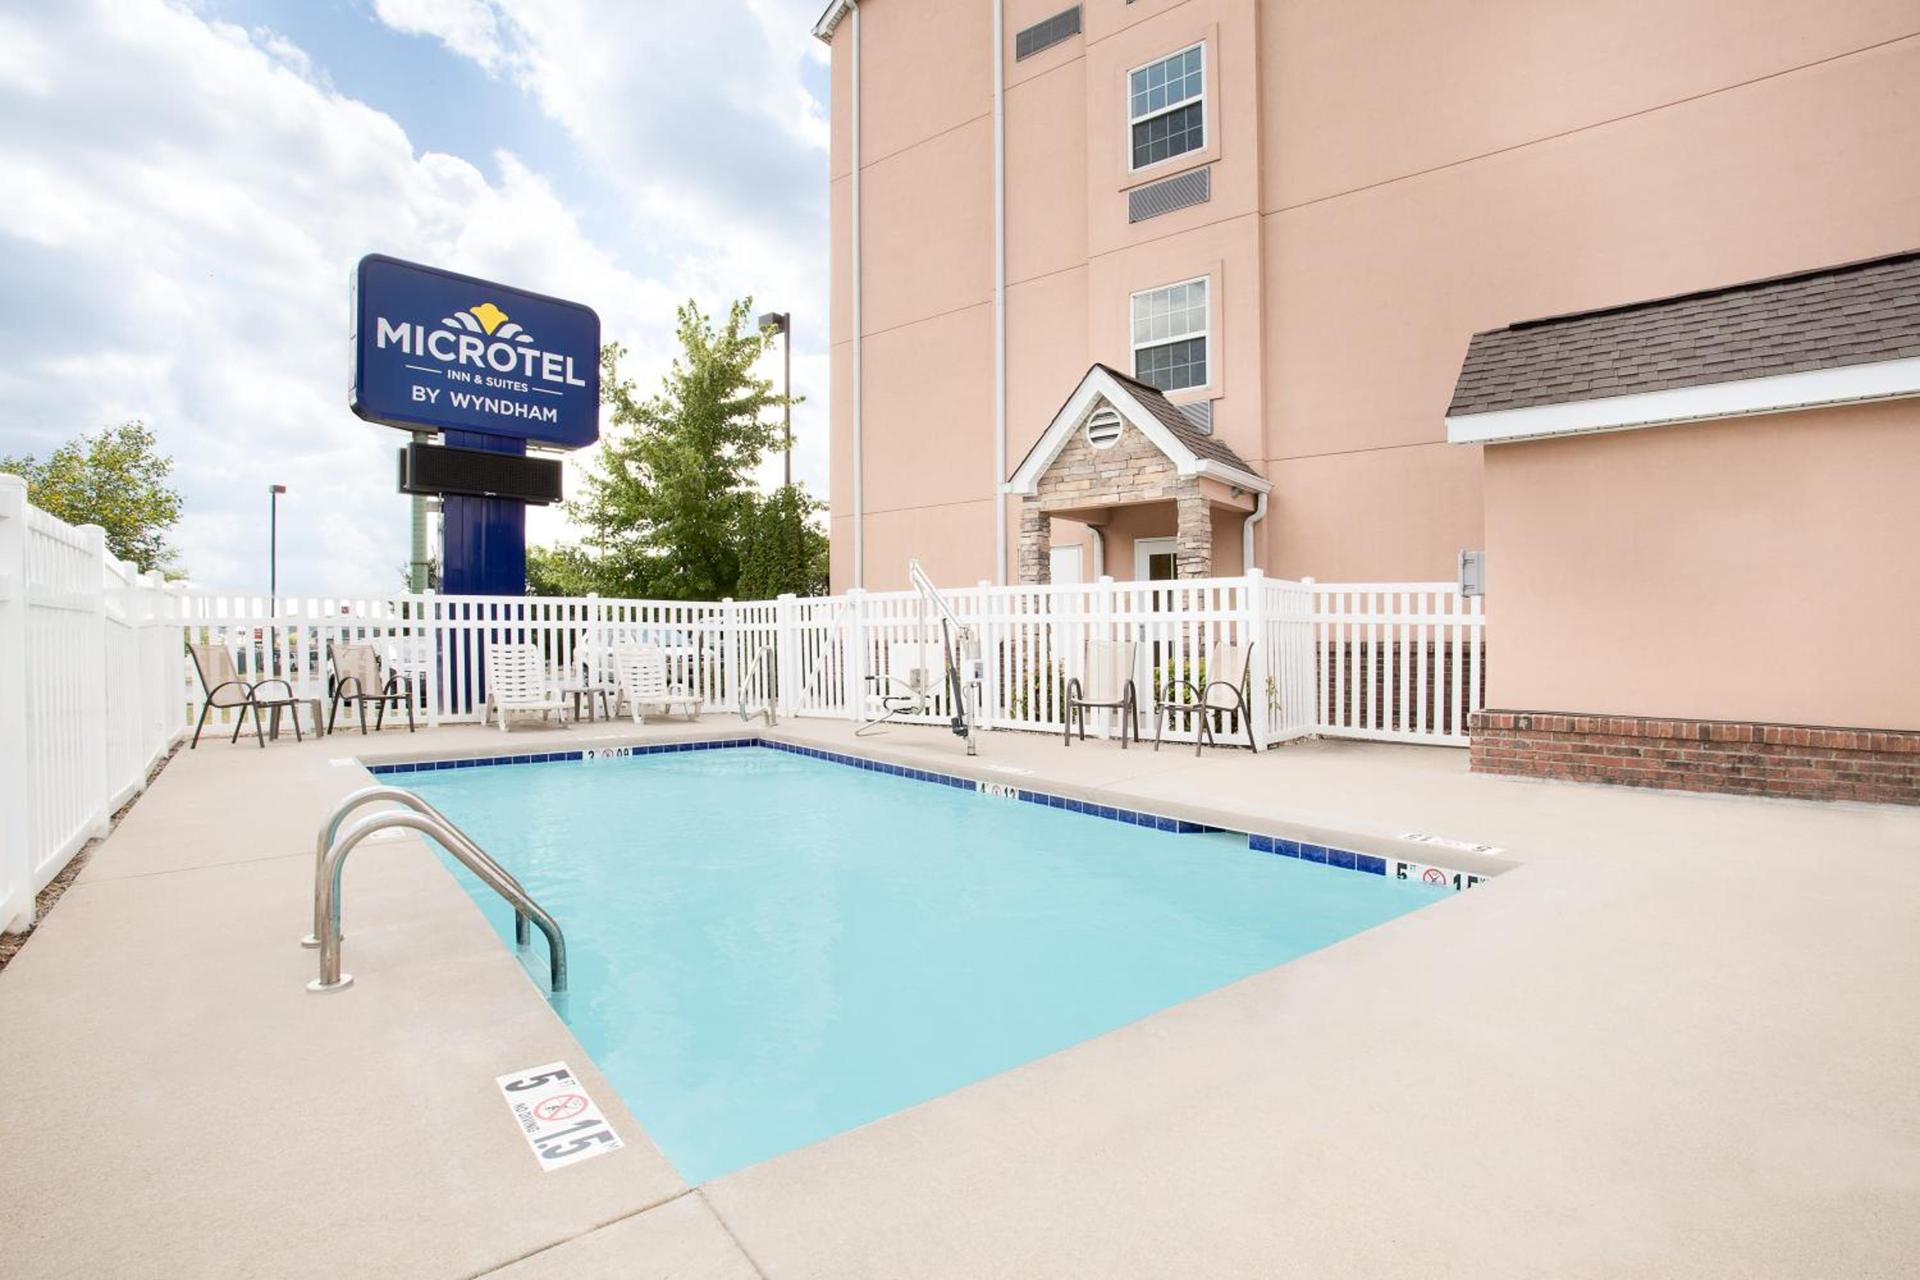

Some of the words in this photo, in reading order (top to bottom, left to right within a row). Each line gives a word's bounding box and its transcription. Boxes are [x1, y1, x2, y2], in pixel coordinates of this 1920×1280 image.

[376, 316, 586, 387] MICROTEL
[447, 369, 471, 383] INN
[473, 374, 483, 385] &
[486, 376, 529, 393] SUITES
[412, 385, 440, 404] BY
[450, 391, 558, 423] WYNDHAM
[1397, 862, 1407, 880] 5
[505, 1069, 570, 1092] 5
[534, 1119, 615, 1159] 1.5
